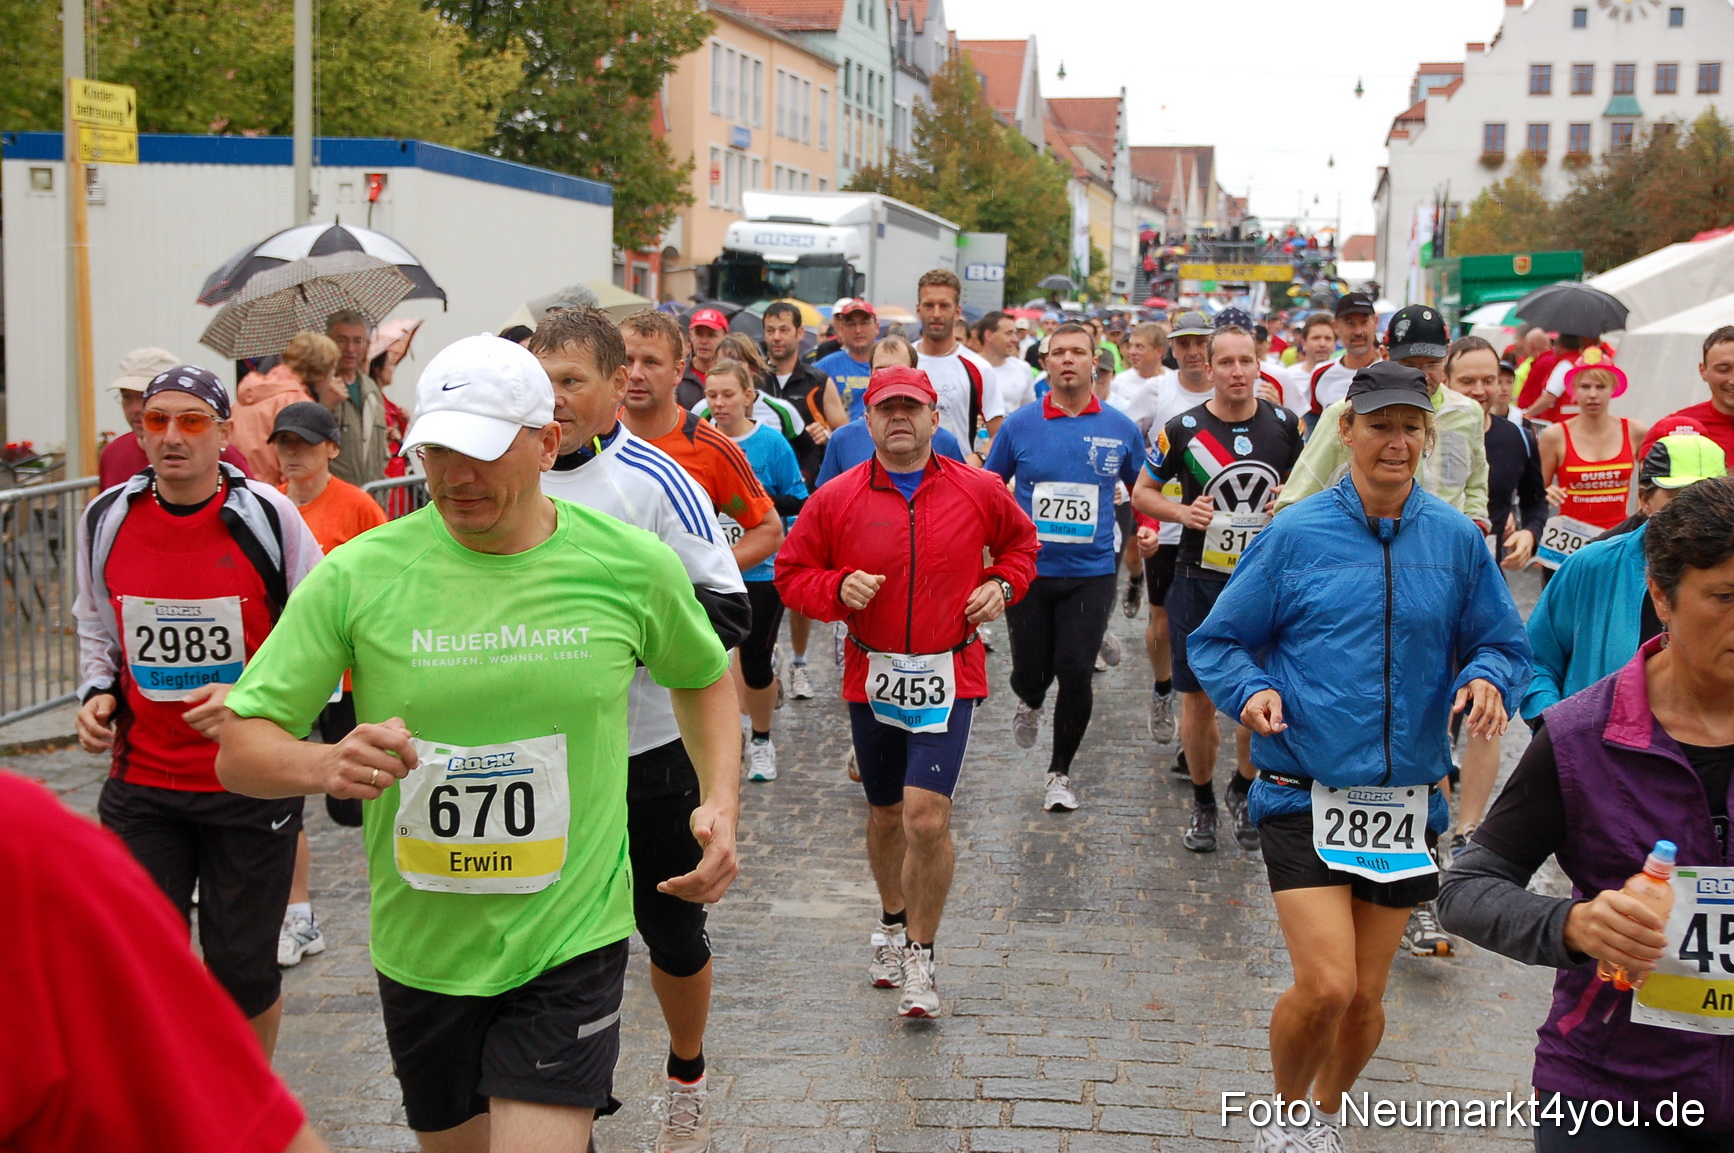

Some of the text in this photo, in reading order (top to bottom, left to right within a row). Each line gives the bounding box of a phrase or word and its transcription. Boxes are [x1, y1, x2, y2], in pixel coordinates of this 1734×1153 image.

[1580, 471, 1622, 482] DURST
[1039, 498, 1091, 521] 2753
[1049, 524, 1076, 534] Stefan
[1545, 527, 1590, 555] 239
[156, 606, 201, 616] BOCK
[136, 625, 232, 664] 2983
[411, 649, 593, 668] EINKAUFEN. WOHNEN. LEBEN.
[892, 660, 927, 669] BOCK
[150, 670, 219, 688] Siegfried
[875, 673, 946, 707] 2453
[447, 752, 516, 772] BOCK
[1347, 790, 1394, 802] BOCK
[429, 781, 536, 838] 670
[1325, 808, 1415, 849] 2824
[450, 851, 513, 872] Erwin
[1356, 856, 1390, 870] Ruth
